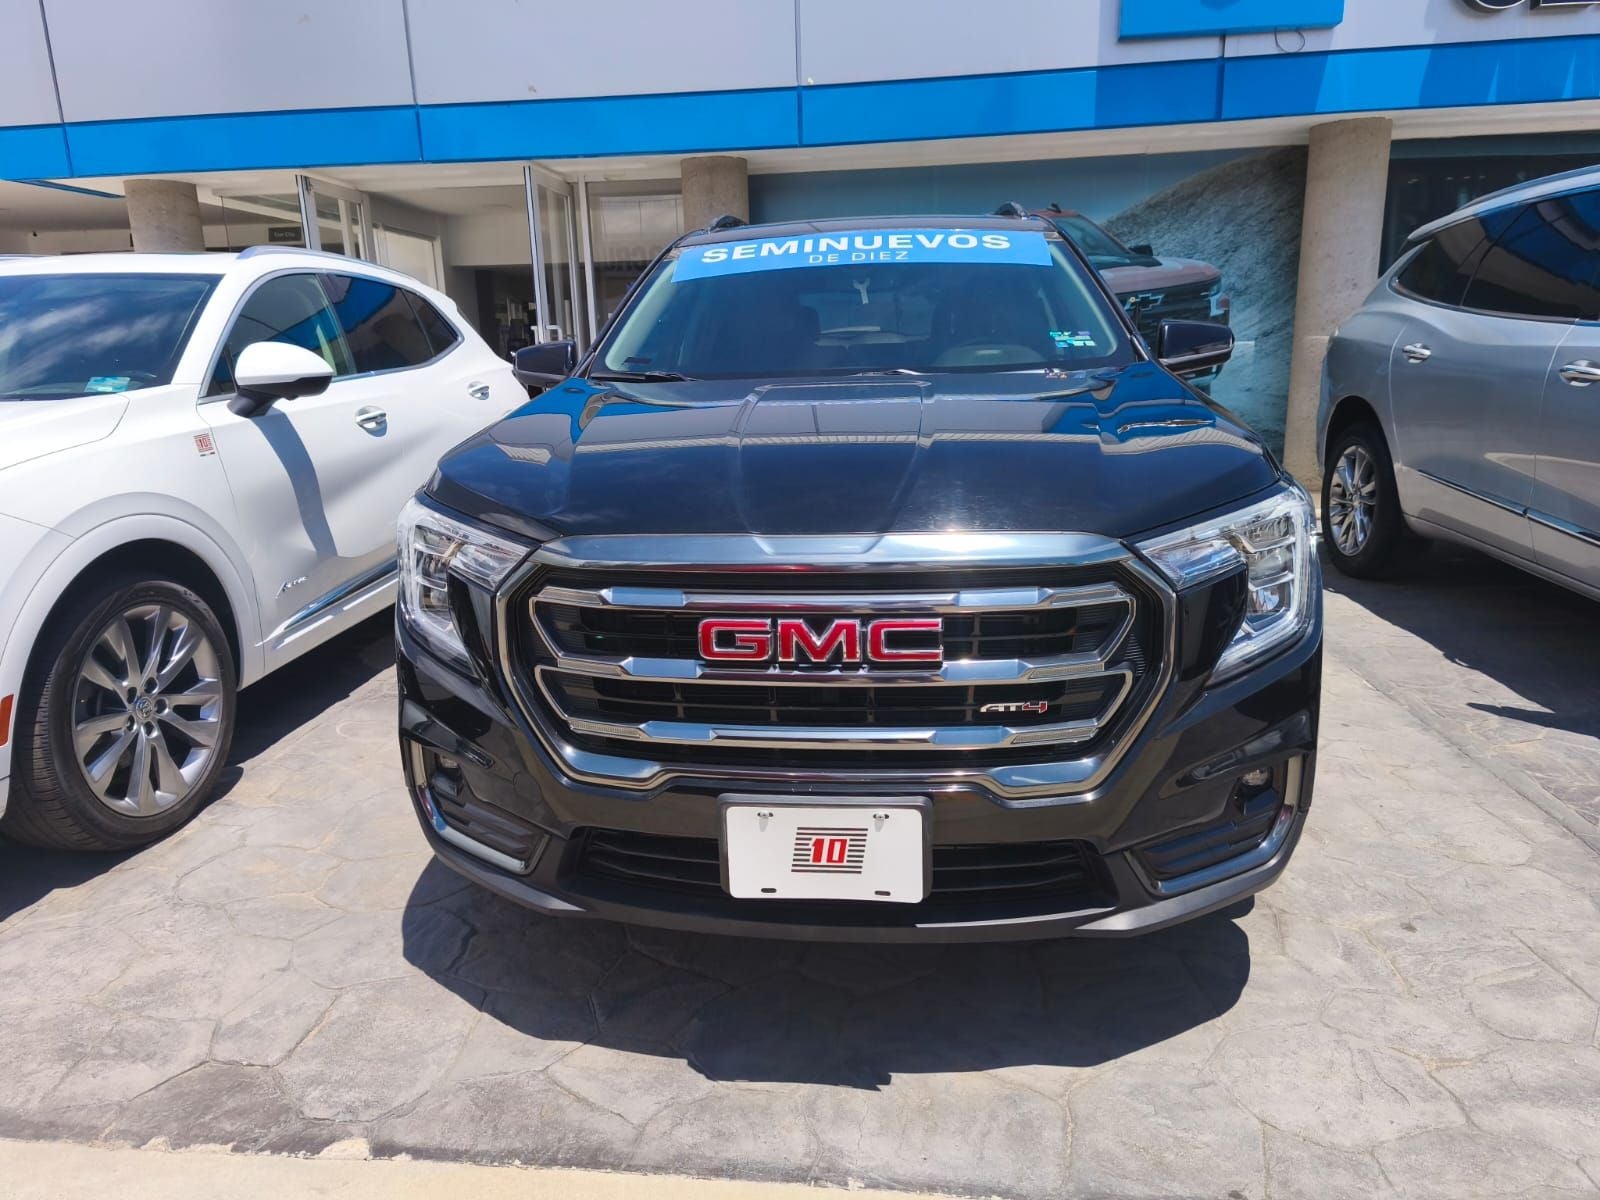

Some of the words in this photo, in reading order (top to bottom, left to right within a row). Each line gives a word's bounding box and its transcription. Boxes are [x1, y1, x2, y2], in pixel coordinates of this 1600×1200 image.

[701, 233, 1011, 263] SEMINUEVOS
[808, 253, 839, 264] DE
[851, 250, 909, 262] DIEZ
[698, 618, 944, 662] GMC
[980, 701, 1048, 714] AT4
[811, 838, 848, 863] 10
